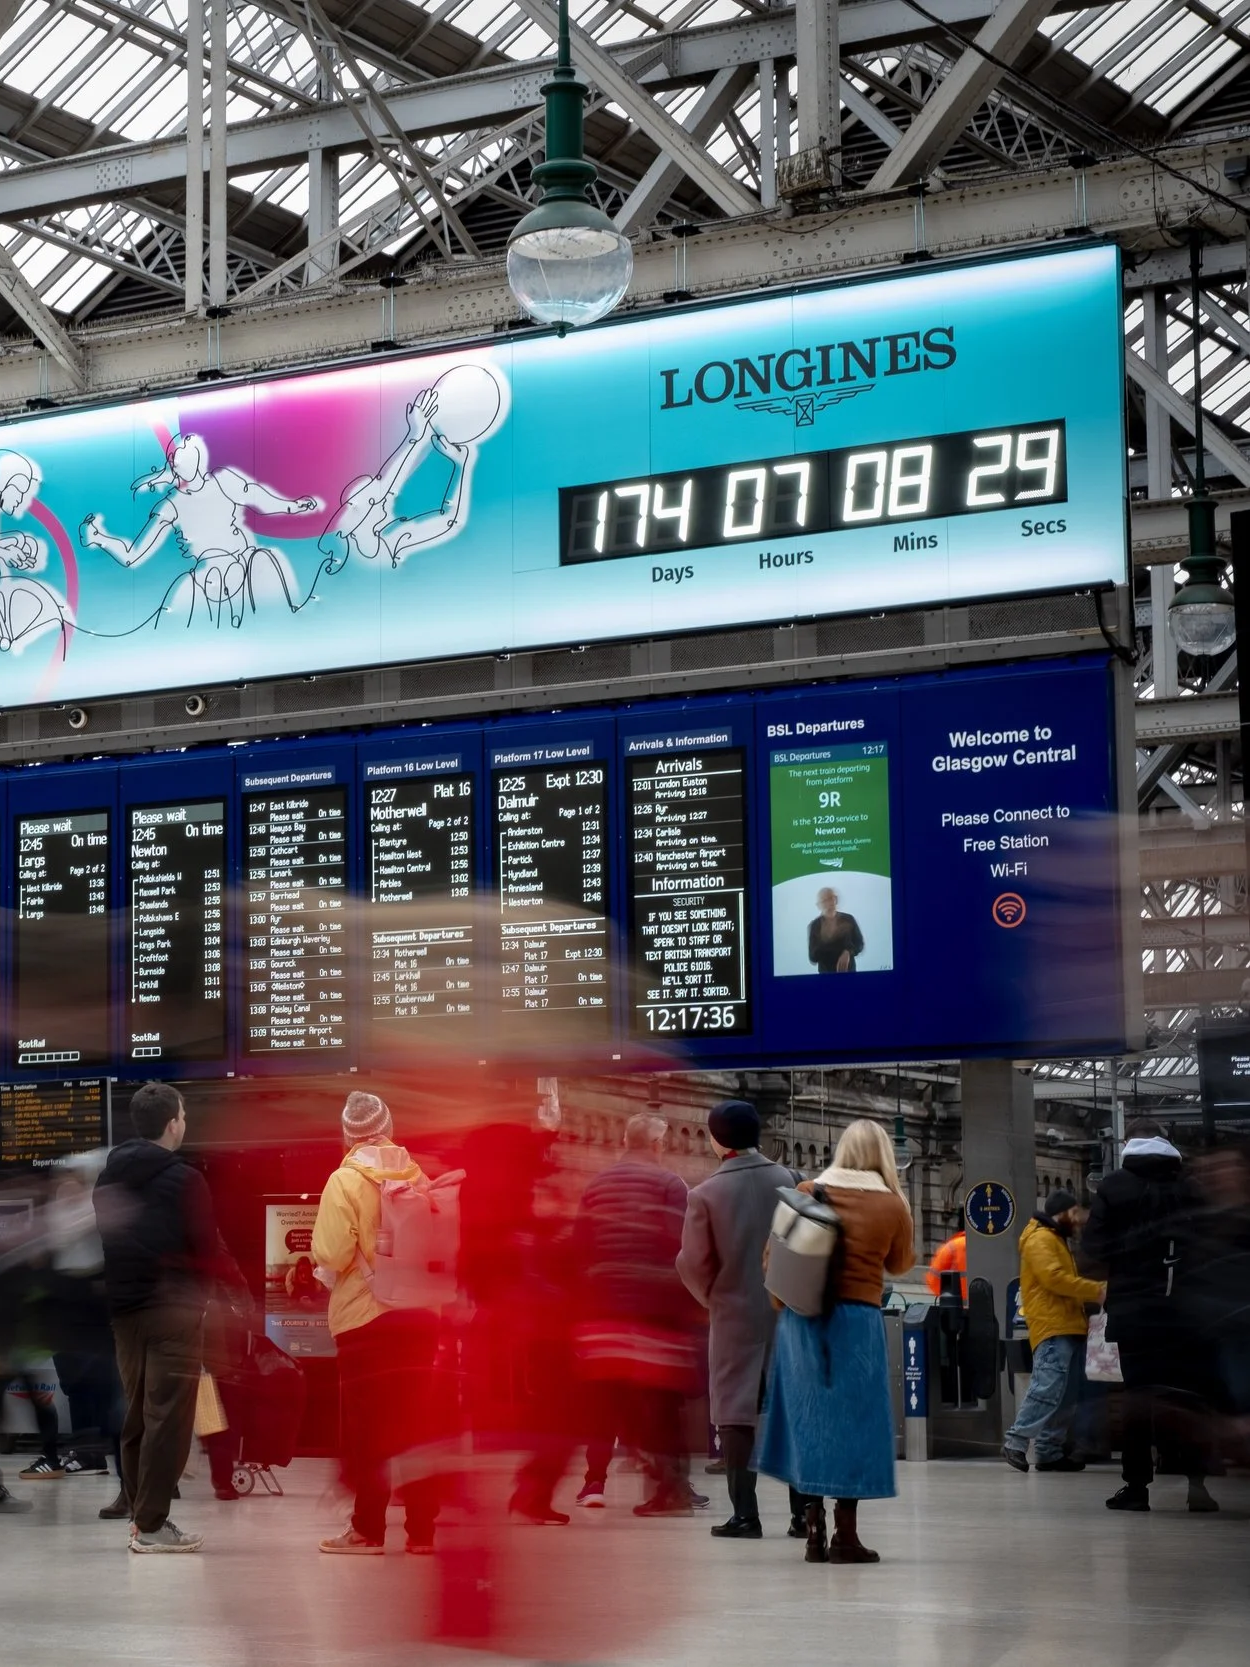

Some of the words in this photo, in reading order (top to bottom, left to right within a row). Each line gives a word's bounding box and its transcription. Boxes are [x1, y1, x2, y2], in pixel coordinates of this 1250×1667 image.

[660, 326, 957, 410] LONGINES
[594, 478, 692, 554] 174
[723, 460, 811, 539] 07
[842, 444, 933, 522] 08
[966, 428, 1060, 507] 29
[652, 563, 694, 585] Days
[759, 548, 813, 569] Hours
[893, 532, 938, 552] Mins
[1021, 517, 1067, 537] Secs
[767, 724, 793, 737] BSL
[796, 719, 865, 736] Departures
[629, 738, 664, 751] Arrivals
[665, 738, 674, 748] &
[675, 733, 728, 747] Information
[949, 729, 1029, 748] Welcome
[1034, 726, 1052, 742] to
[495, 752, 530, 764] Platform
[534, 752, 544, 760] 17
[546, 750, 564, 759] Low
[566, 746, 590, 757] Level
[774, 754, 788, 762] BSL
[790, 751, 831, 762] Departures
[862, 745, 884, 755] 12:17
[932, 751, 1007, 774] Glasgow
[1013, 745, 1077, 765] Central
[367, 764, 402, 776] Platform
[404, 763, 414, 772] 16
[416, 761, 432, 771] Low
[433, 760, 458, 770] Level
[656, 758, 702, 774] Arrivals
[803, 768, 818, 776] next
[819, 767, 835, 775] train
[837, 764, 870, 775] departing
[245, 775, 289, 787] Subsequent
[291, 771, 332, 783] Departures
[498, 777, 526, 792] 12:25
[546, 774, 570, 790] Expt
[576, 770, 603, 785] 12:30
[633, 781, 651, 792] 12:01
[655, 778, 680, 789] London
[682, 776, 708, 787] Euston
[806, 778, 822, 786] from
[824, 776, 853, 786] platform
[371, 788, 397, 804] 12:27
[434, 784, 454, 798] Plat
[459, 782, 470, 796] 16
[818, 791, 841, 808] 9R
[250, 803, 266, 812] 12:47
[270, 802, 284, 811] East
[286, 799, 308, 809] Kilbride
[498, 794, 538, 810] Dalmuir
[132, 811, 163, 824] Please
[167, 809, 186, 821] wait
[371, 802, 426, 821] Motherwell
[813, 815, 835, 824] 12:20
[942, 812, 989, 828] Please
[994, 806, 1053, 823] Connect
[1056, 805, 1070, 819] to
[132, 828, 156, 842] 12:45
[185, 825, 199, 838] On
[202, 823, 223, 836] time
[508, 826, 543, 836] Anderston
[582, 821, 600, 831] 12:31
[815, 826, 846, 836] Newton
[20, 838, 42, 852] 12:45
[964, 837, 996, 852] Free
[1000, 834, 1049, 849] Station
[131, 845, 167, 858] Newton
[20, 854, 45, 868] Largs
[990, 862, 1028, 878] Wi-Fi
[652, 874, 724, 891] Information
[673, 896, 705, 907] SECURITY
[648, 912, 658, 922] IF
[660, 911, 672, 922] YOU
[674, 910, 687, 920] SEE
[689, 908, 726, 919] SOMETHING
[642, 925, 659, 936] THAT
[661, 923, 690, 935] DOESN'T
[692, 922, 710, 933] LOOK
[712, 921, 734, 932] RIGHT;
[654, 937, 675, 948] SPEAK
[678, 936, 686, 946] TO
[689, 935, 711, 946] STAFF
[712, 934, 722, 944] OR
[645, 950, 663, 961] TEXT
[665, 948, 692, 960] BRITISH
[694, 946, 732, 958] TRANSPORT
[664, 961, 688, 972] POLICE
[690, 960, 713, 971] 61016.
[663, 975, 683, 985] WE'LL
[685, 974, 702, 984] SORT
[705, 973, 715, 983] IT.
[647, 989, 660, 999] SEE
[663, 988, 673, 998] IT.
[675, 988, 688, 998] SAY
[690, 987, 700, 997] IT.
[702, 985, 731, 997] SORTED.
[646, 1006, 735, 1032] 12:17:36
